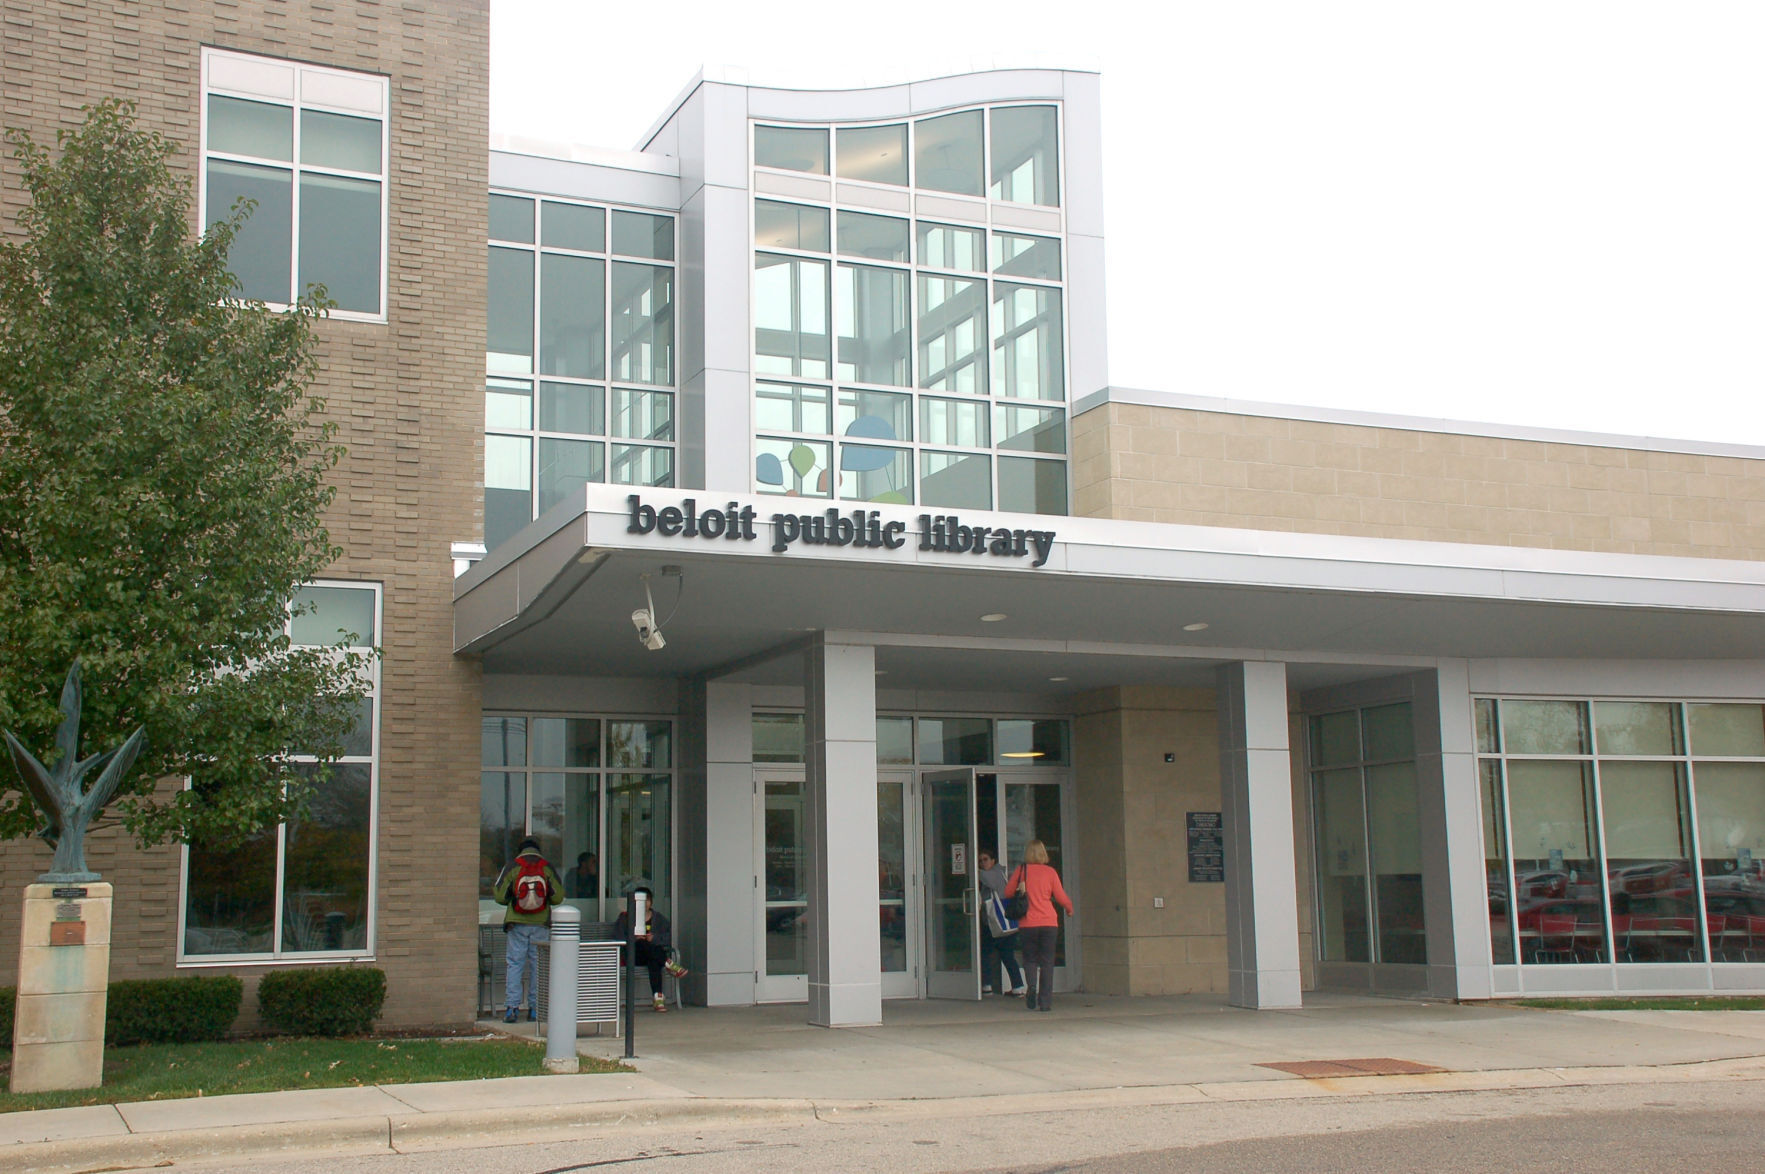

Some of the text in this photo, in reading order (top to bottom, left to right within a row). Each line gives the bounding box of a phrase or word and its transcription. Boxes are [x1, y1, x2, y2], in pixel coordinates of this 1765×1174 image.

[627, 495, 1056, 567] beloit public library
